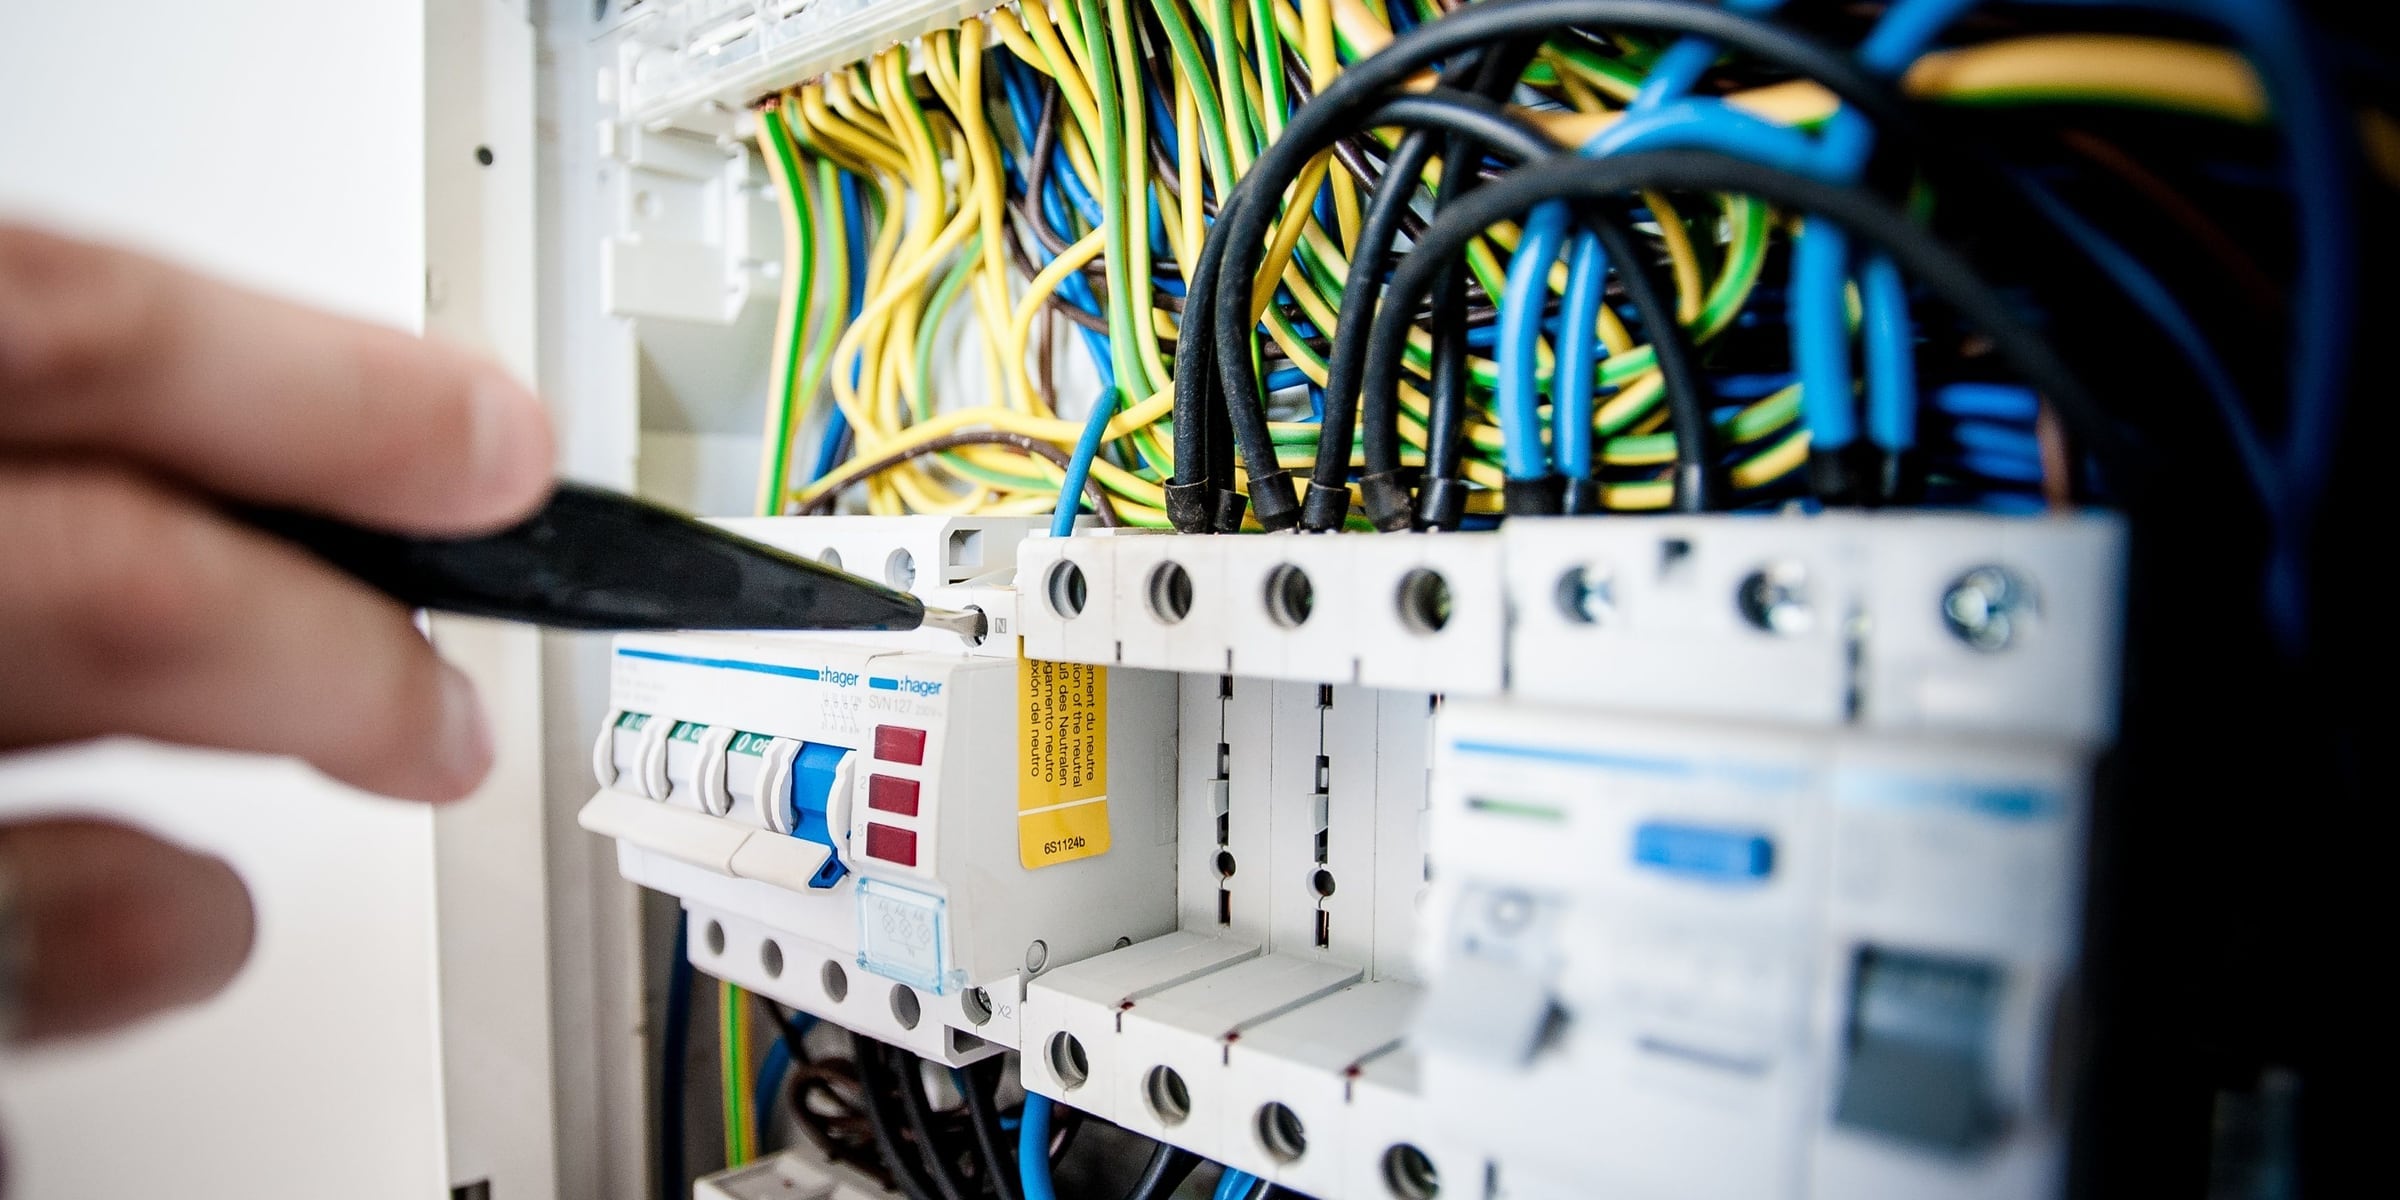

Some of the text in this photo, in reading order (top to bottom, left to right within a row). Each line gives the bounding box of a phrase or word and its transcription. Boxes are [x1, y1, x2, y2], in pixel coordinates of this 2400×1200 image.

[1058, 685, 1070, 712] des
[1072, 696, 1083, 707] of
[1030, 702, 1040, 725] del
[1072, 711, 1083, 735] the
[1086, 712, 1095, 731] du
[1030, 729, 1040, 777] neutro
[1045, 735, 1055, 783] neutro
[1058, 716, 1070, 787] Neutralen
[1072, 739, 1083, 788] neutral
[1086, 735, 1095, 781] neutre
[1044, 835, 1086, 855] 6S1124b
[997, 1002, 1012, 1020] X2
